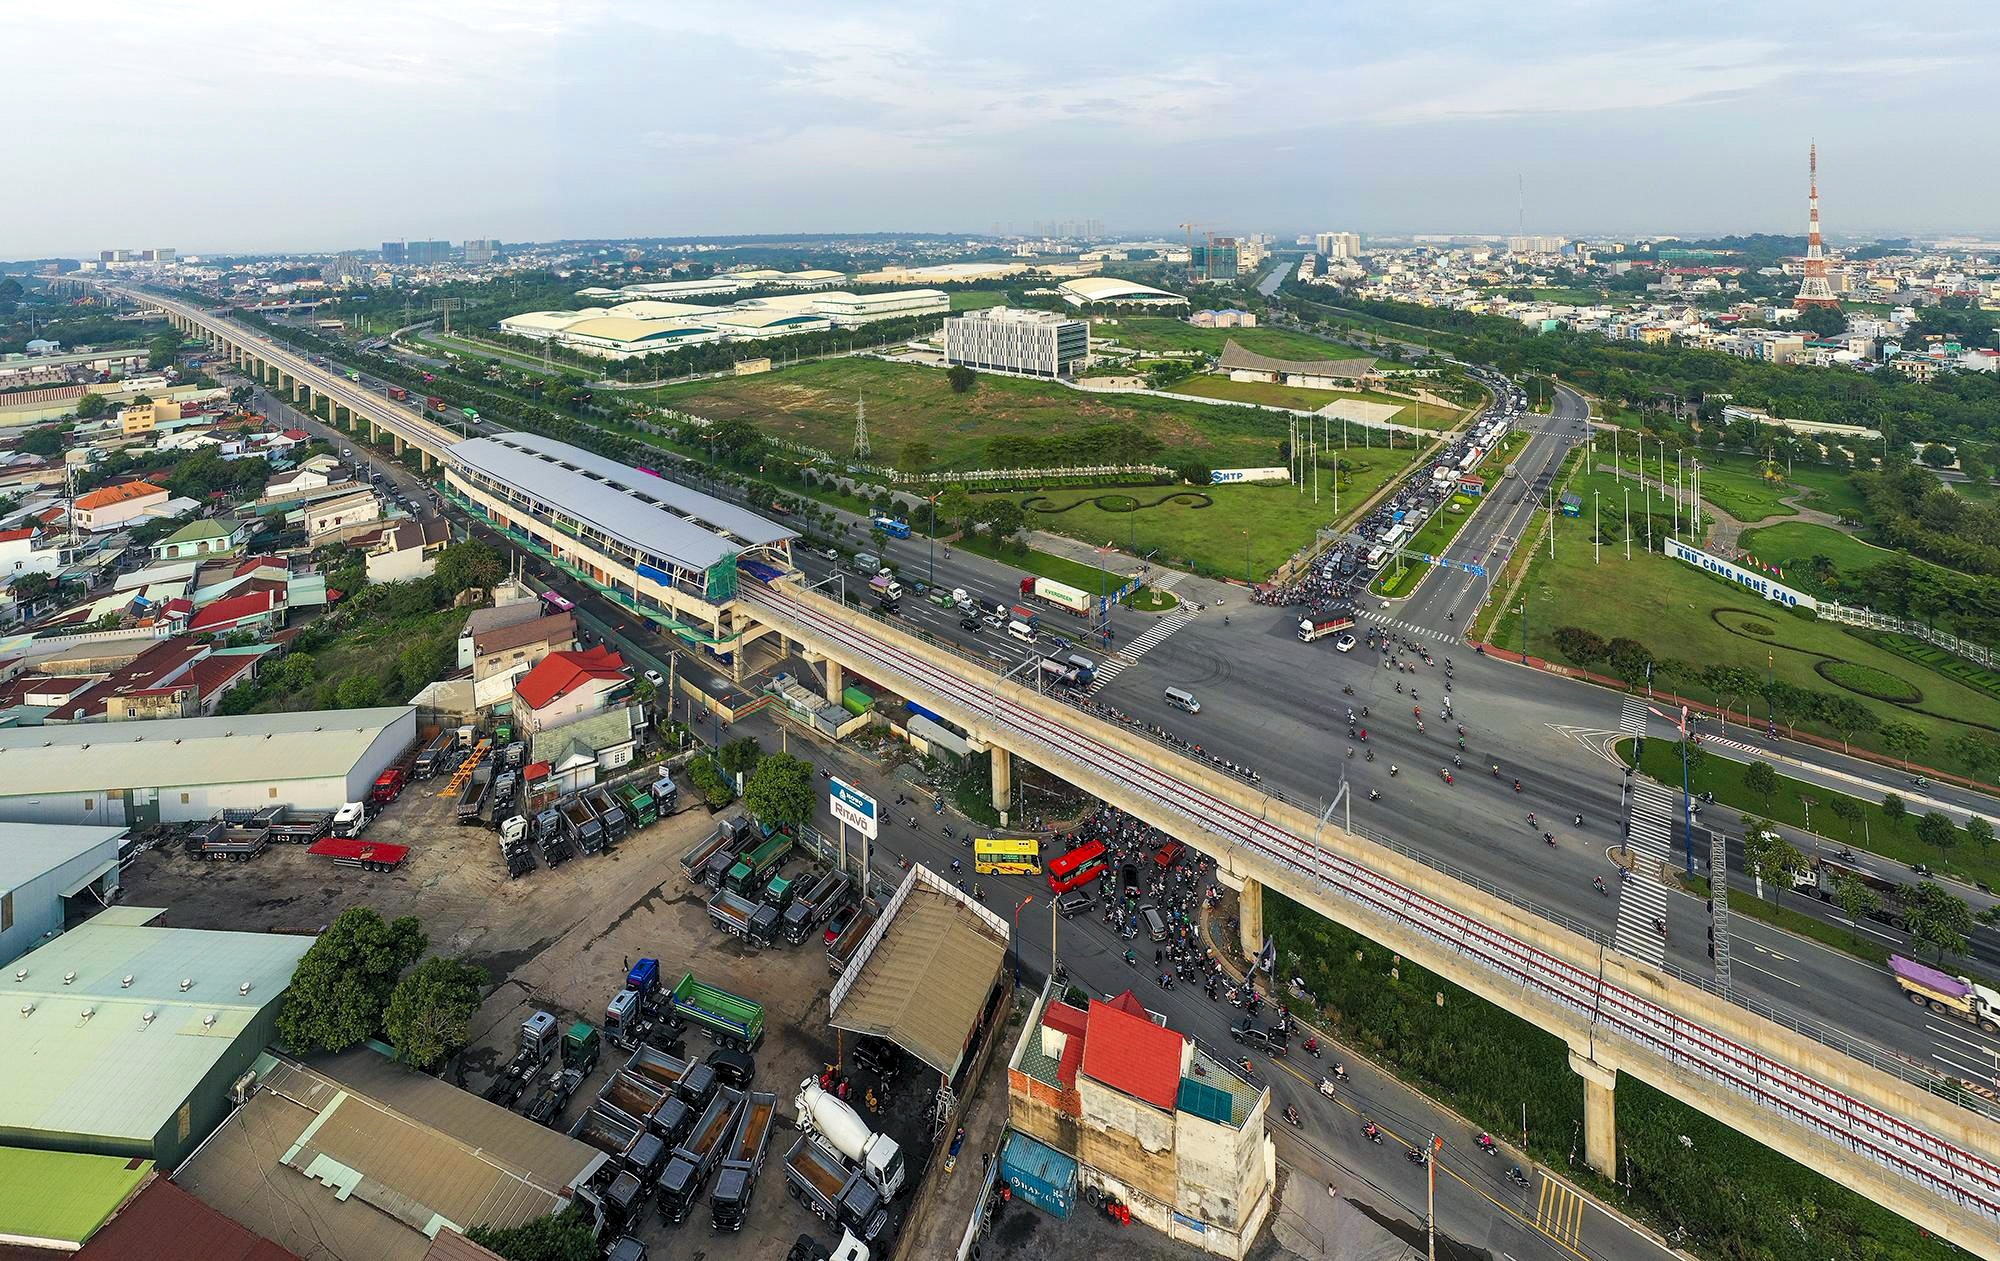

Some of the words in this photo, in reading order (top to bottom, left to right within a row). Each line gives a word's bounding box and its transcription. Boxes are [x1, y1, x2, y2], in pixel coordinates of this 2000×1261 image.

[1677, 547, 1698, 564] KHU
[1702, 560, 1732, 579] CÔNG
[1773, 589, 1797, 606] CAO
[1045, 589, 1073, 602] EVERGREEN
